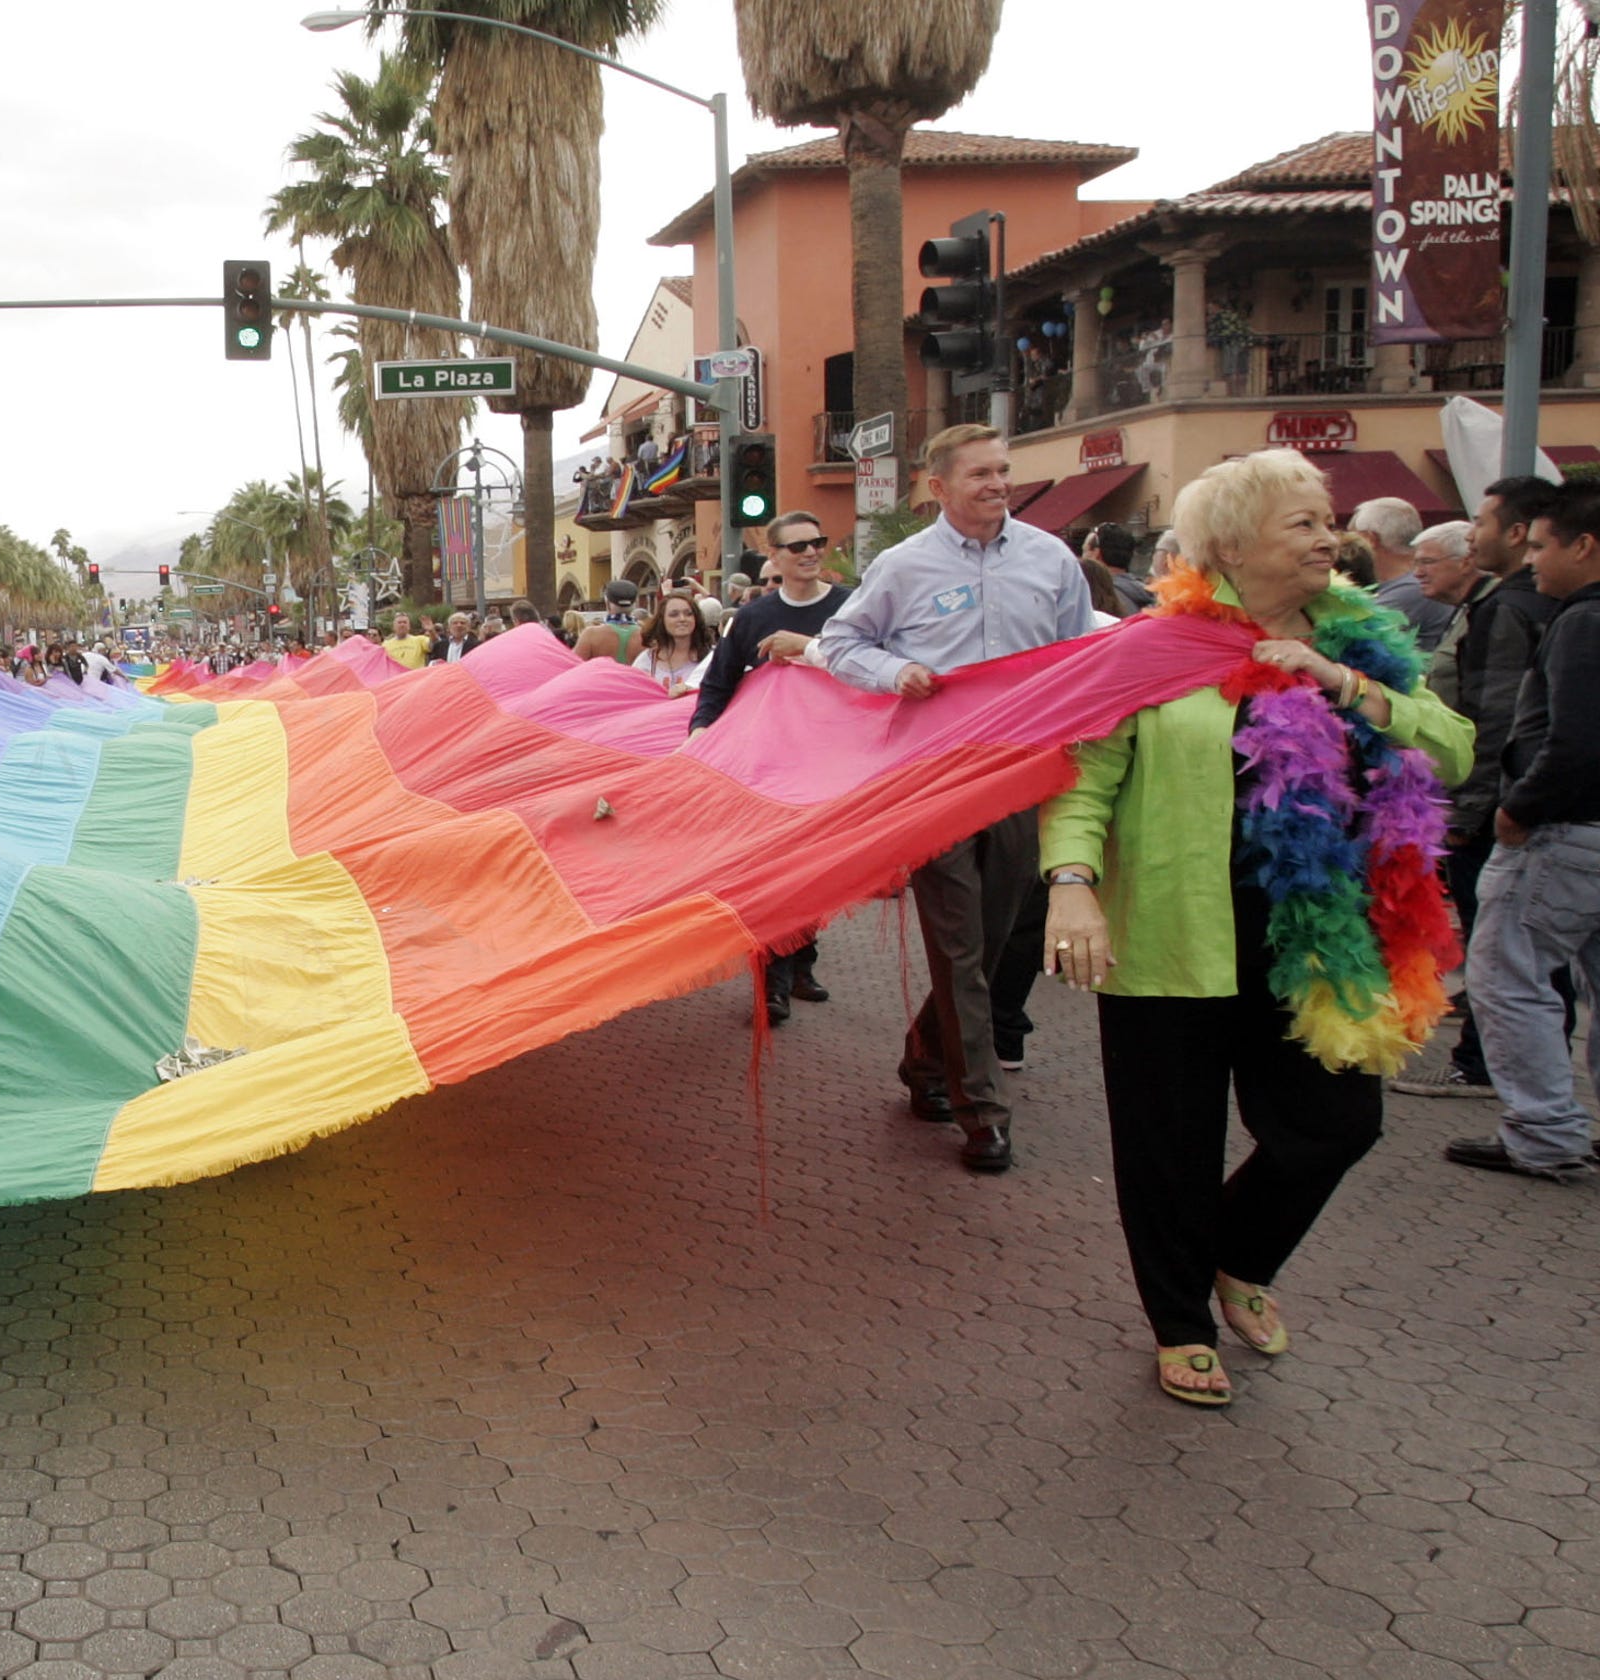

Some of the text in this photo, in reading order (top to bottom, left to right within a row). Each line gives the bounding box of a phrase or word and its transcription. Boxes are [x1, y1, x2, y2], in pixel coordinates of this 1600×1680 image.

[1373, 4, 1410, 324] DOWNTOWN
[1449, 230, 1473, 244] the
[399, 370, 494, 388] La Plaza
[859, 461, 873, 475] NO
[858, 477, 895, 488] PARKING
